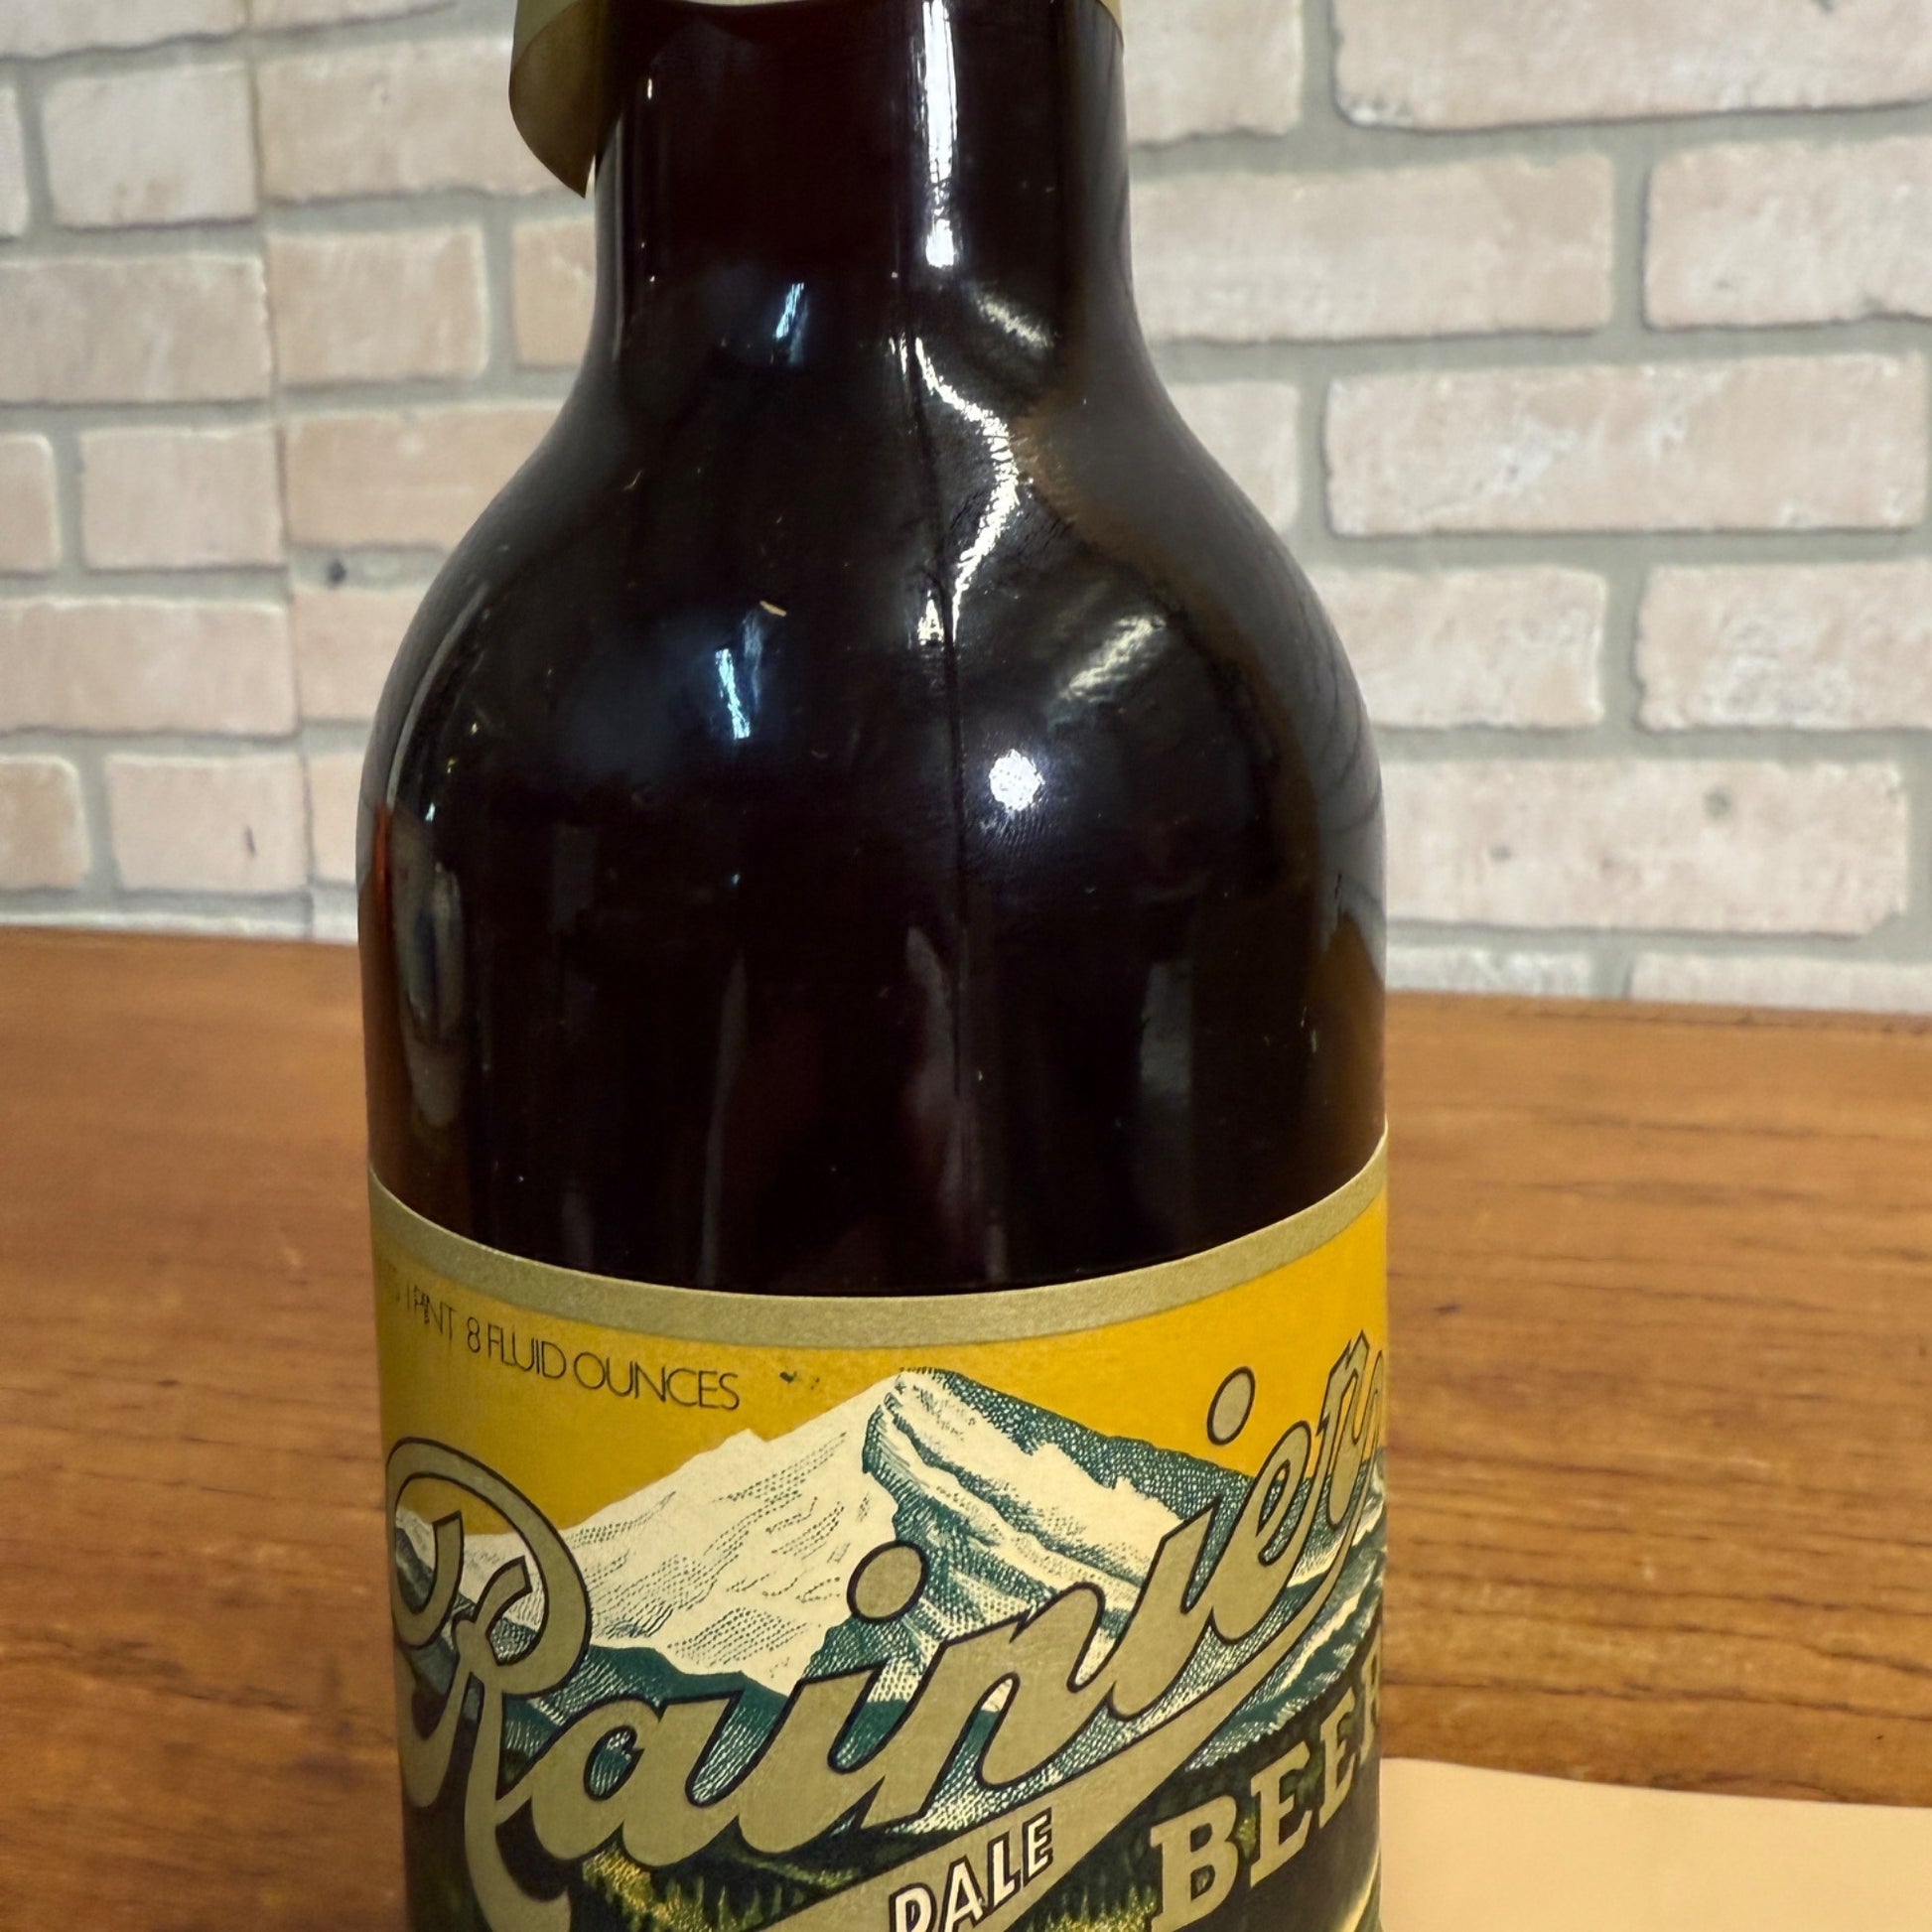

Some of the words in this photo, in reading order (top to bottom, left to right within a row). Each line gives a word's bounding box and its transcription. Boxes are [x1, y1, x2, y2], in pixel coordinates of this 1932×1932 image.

[467, 1316, 482, 1353] 8
[486, 1322, 567, 1380] FLUID
[573, 1350, 741, 1412] OUNCES
[385, 1328, 1386, 1932] Rainier
[889, 1807, 1054, 1932] PALE
